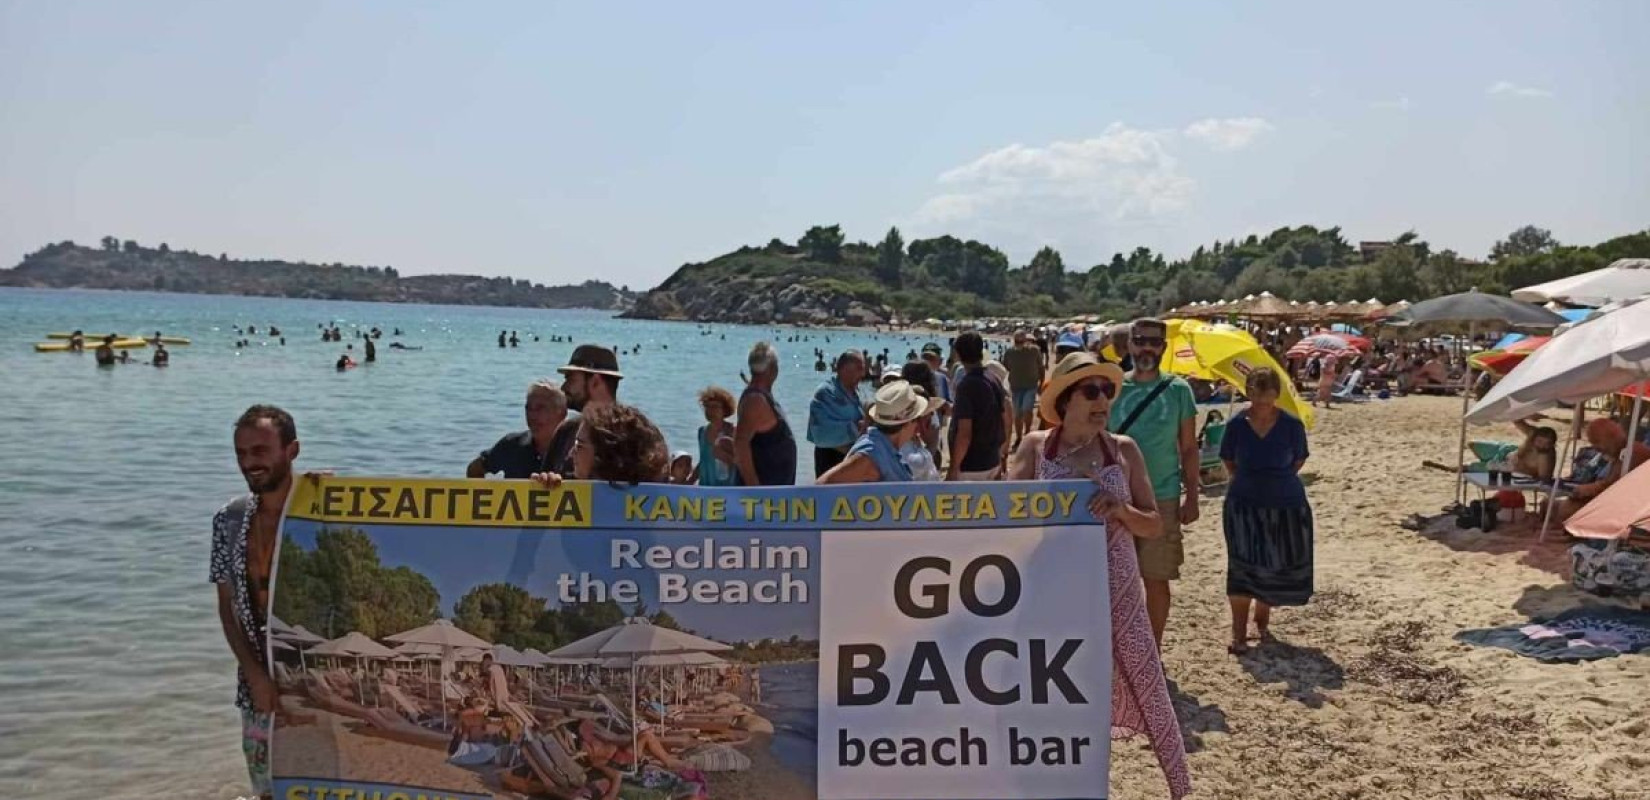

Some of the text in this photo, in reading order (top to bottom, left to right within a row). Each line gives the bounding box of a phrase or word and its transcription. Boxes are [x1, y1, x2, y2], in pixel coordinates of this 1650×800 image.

[323, 485, 584, 523] ΕΙΣΑΓΓΕΛΕΑ
[624, 491, 1078, 522] ΚΑΝΕ ΤΗΝ ΔΟΥΛΕΙΑ ΣΟΥ
[611, 538, 809, 569] Reclaim
[557, 572, 809, 603] the Beach
[893, 554, 1022, 619] GO
[836, 638, 1089, 707] BACK
[838, 727, 1090, 767] beach bar
